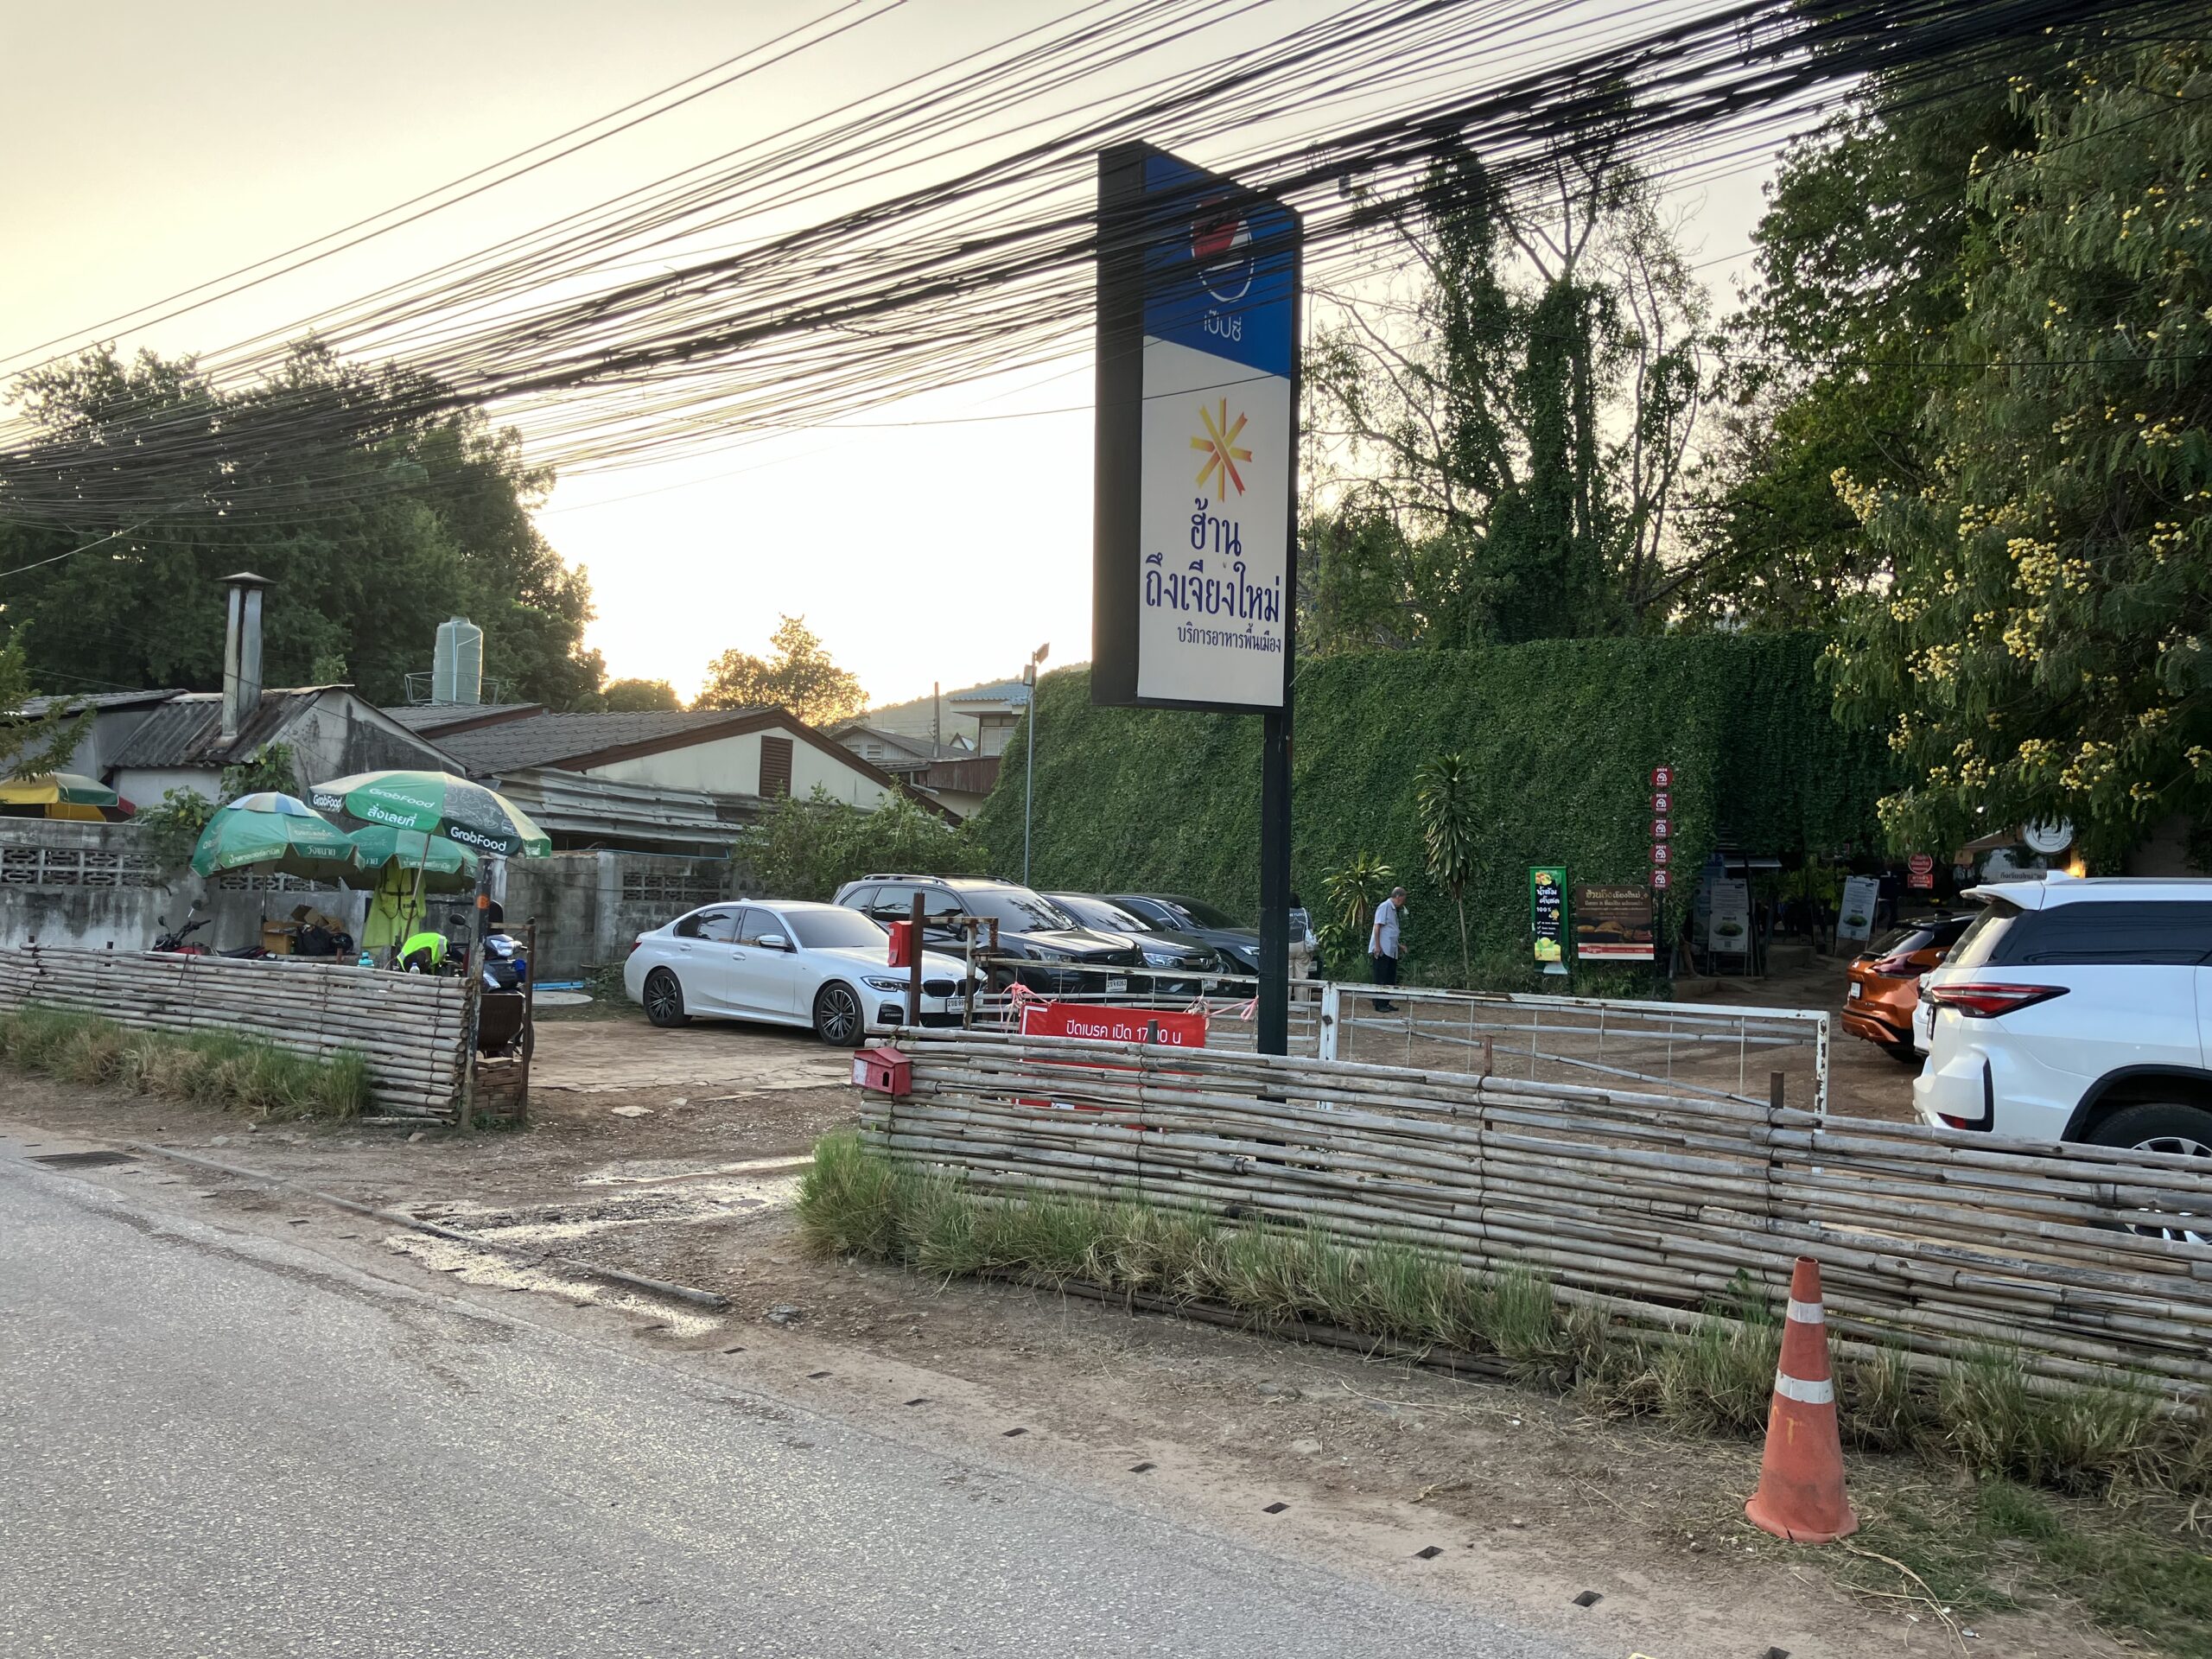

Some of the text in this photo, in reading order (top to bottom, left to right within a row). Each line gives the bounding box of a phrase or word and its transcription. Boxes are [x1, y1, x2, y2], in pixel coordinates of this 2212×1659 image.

[1191, 498, 1242, 556] ฮ้าน
[1145, 551, 1280, 623] ถึงเจียงใหม่
[1177, 620, 1281, 653] บริการอาหารพื้นเมือง
[313, 794, 343, 808] GrabFood
[369, 788, 435, 809] GrabFood
[367, 803, 417, 827] สั่งเลยที่
[450, 826, 507, 852] GrabFood
[1066, 1019, 1109, 1038] ปิดเบรค
[1112, 1023, 1132, 1040] เปิด
